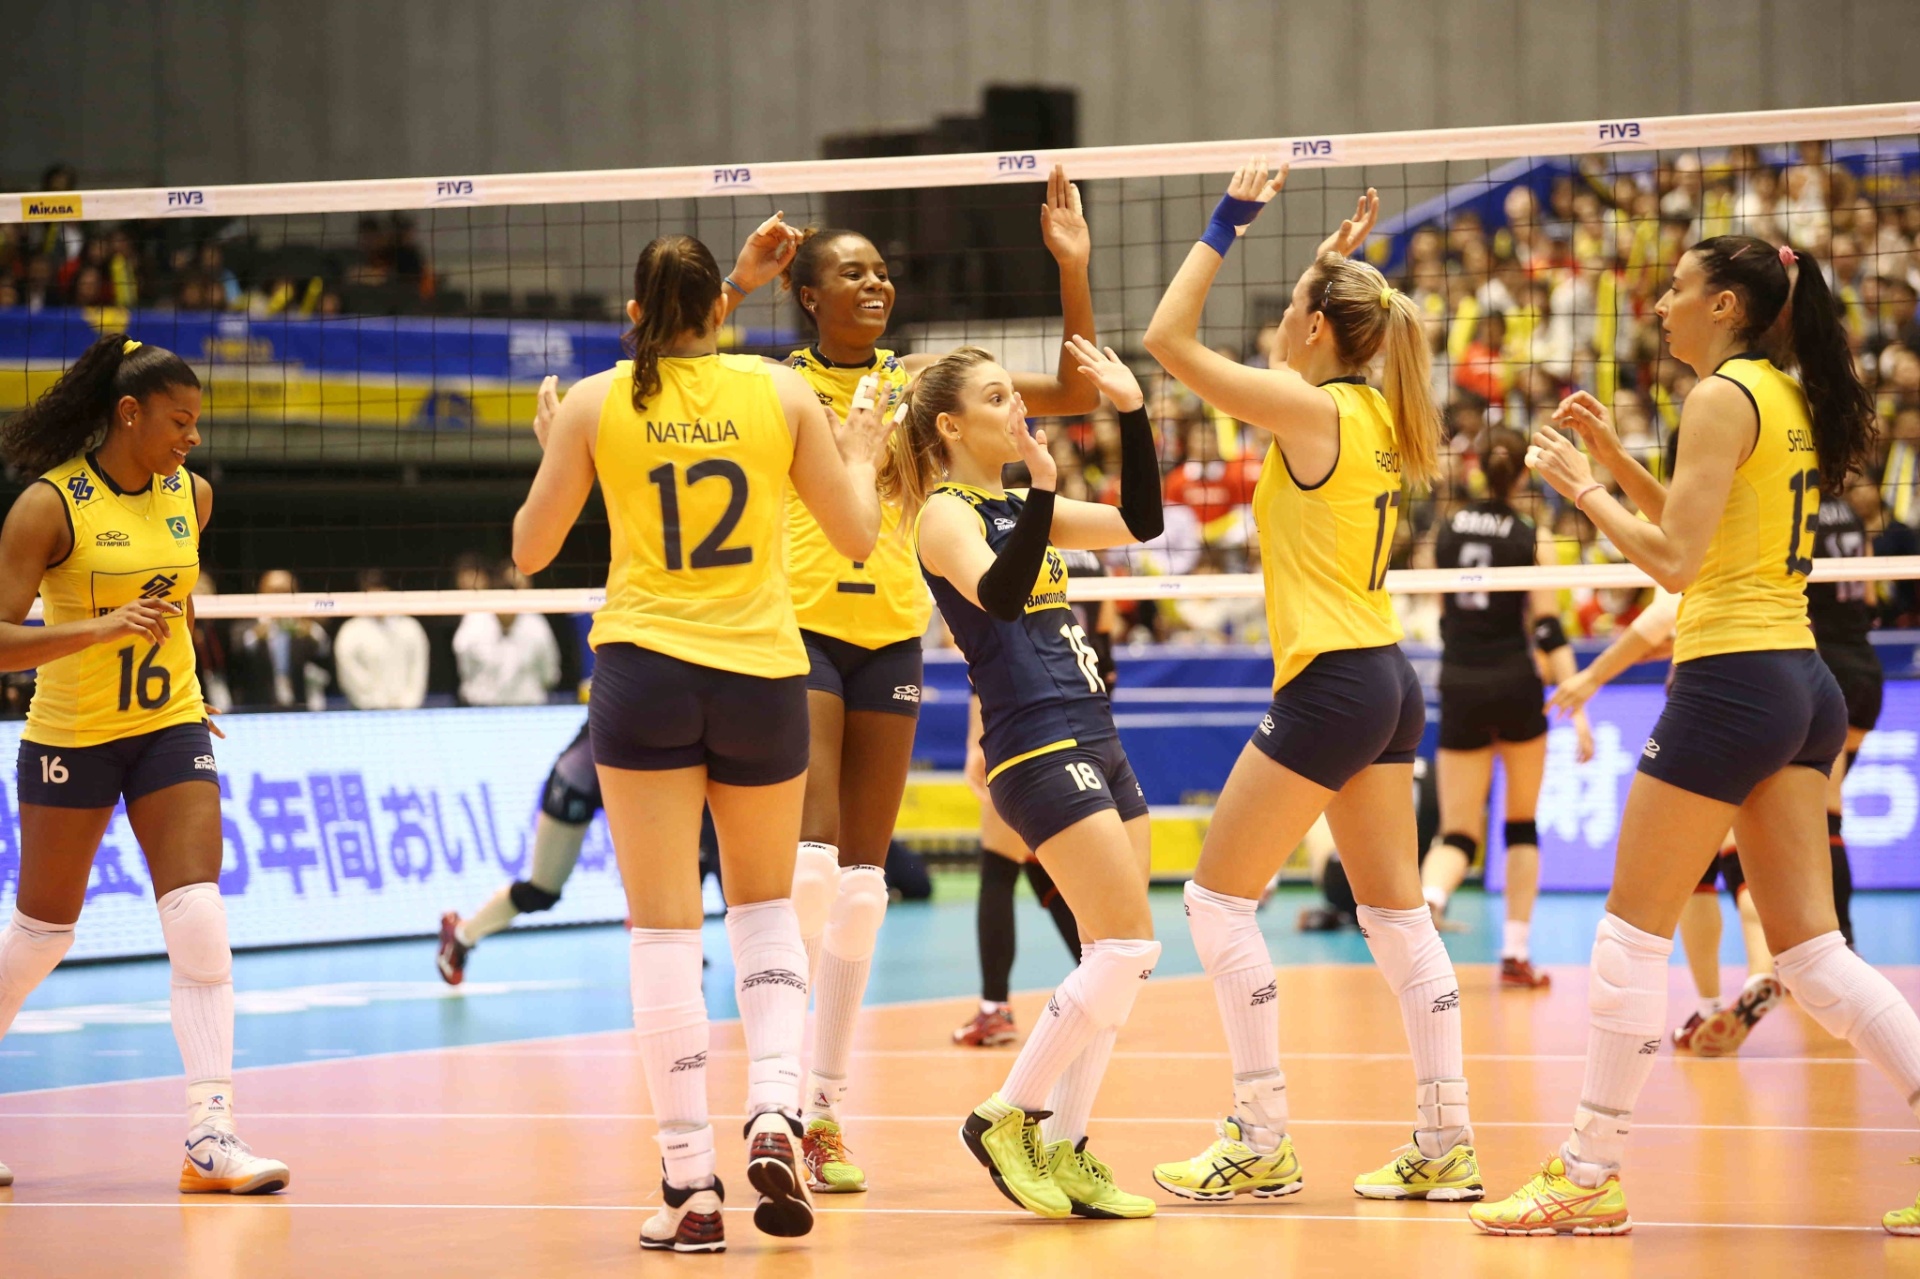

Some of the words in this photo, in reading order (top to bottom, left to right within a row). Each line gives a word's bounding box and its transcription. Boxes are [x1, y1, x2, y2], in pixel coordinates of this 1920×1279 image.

[1600, 123, 1640, 138] FIVB
[1292, 140, 1332, 156] FIVB
[998, 155, 1036, 170] FIVB
[714, 169, 751, 183] FIVB
[437, 181, 473, 195] FIVB
[168, 191, 203, 205] FIVB
[646, 418, 740, 443] NATÁLIA
[649, 458, 753, 571] 12
[117, 641, 171, 712] 16
[40, 755, 69, 784] 16
[1065, 762, 1103, 792] 18
